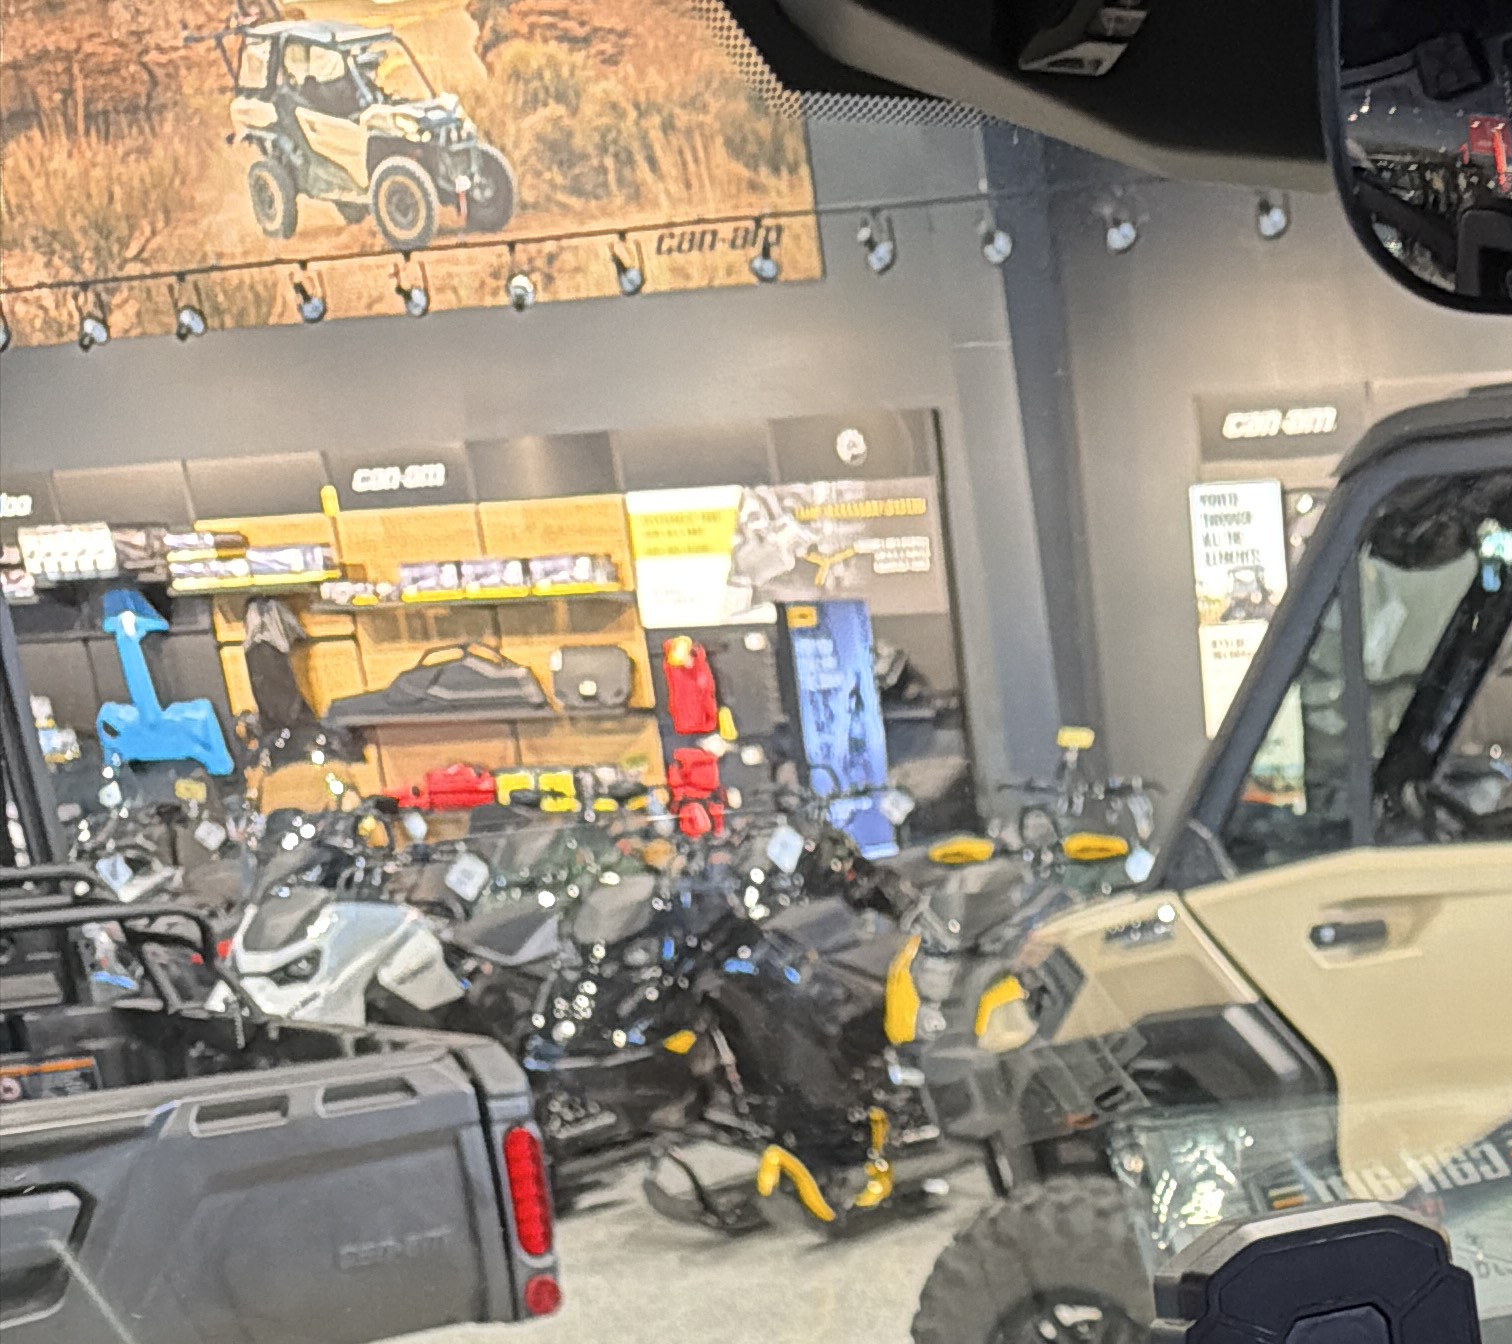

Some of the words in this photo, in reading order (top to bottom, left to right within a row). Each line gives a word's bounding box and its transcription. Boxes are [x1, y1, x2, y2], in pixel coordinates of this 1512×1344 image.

[656, 224, 783, 256] can-am
[1222, 406, 1337, 439] can-am
[352, 463, 445, 492] can-am
